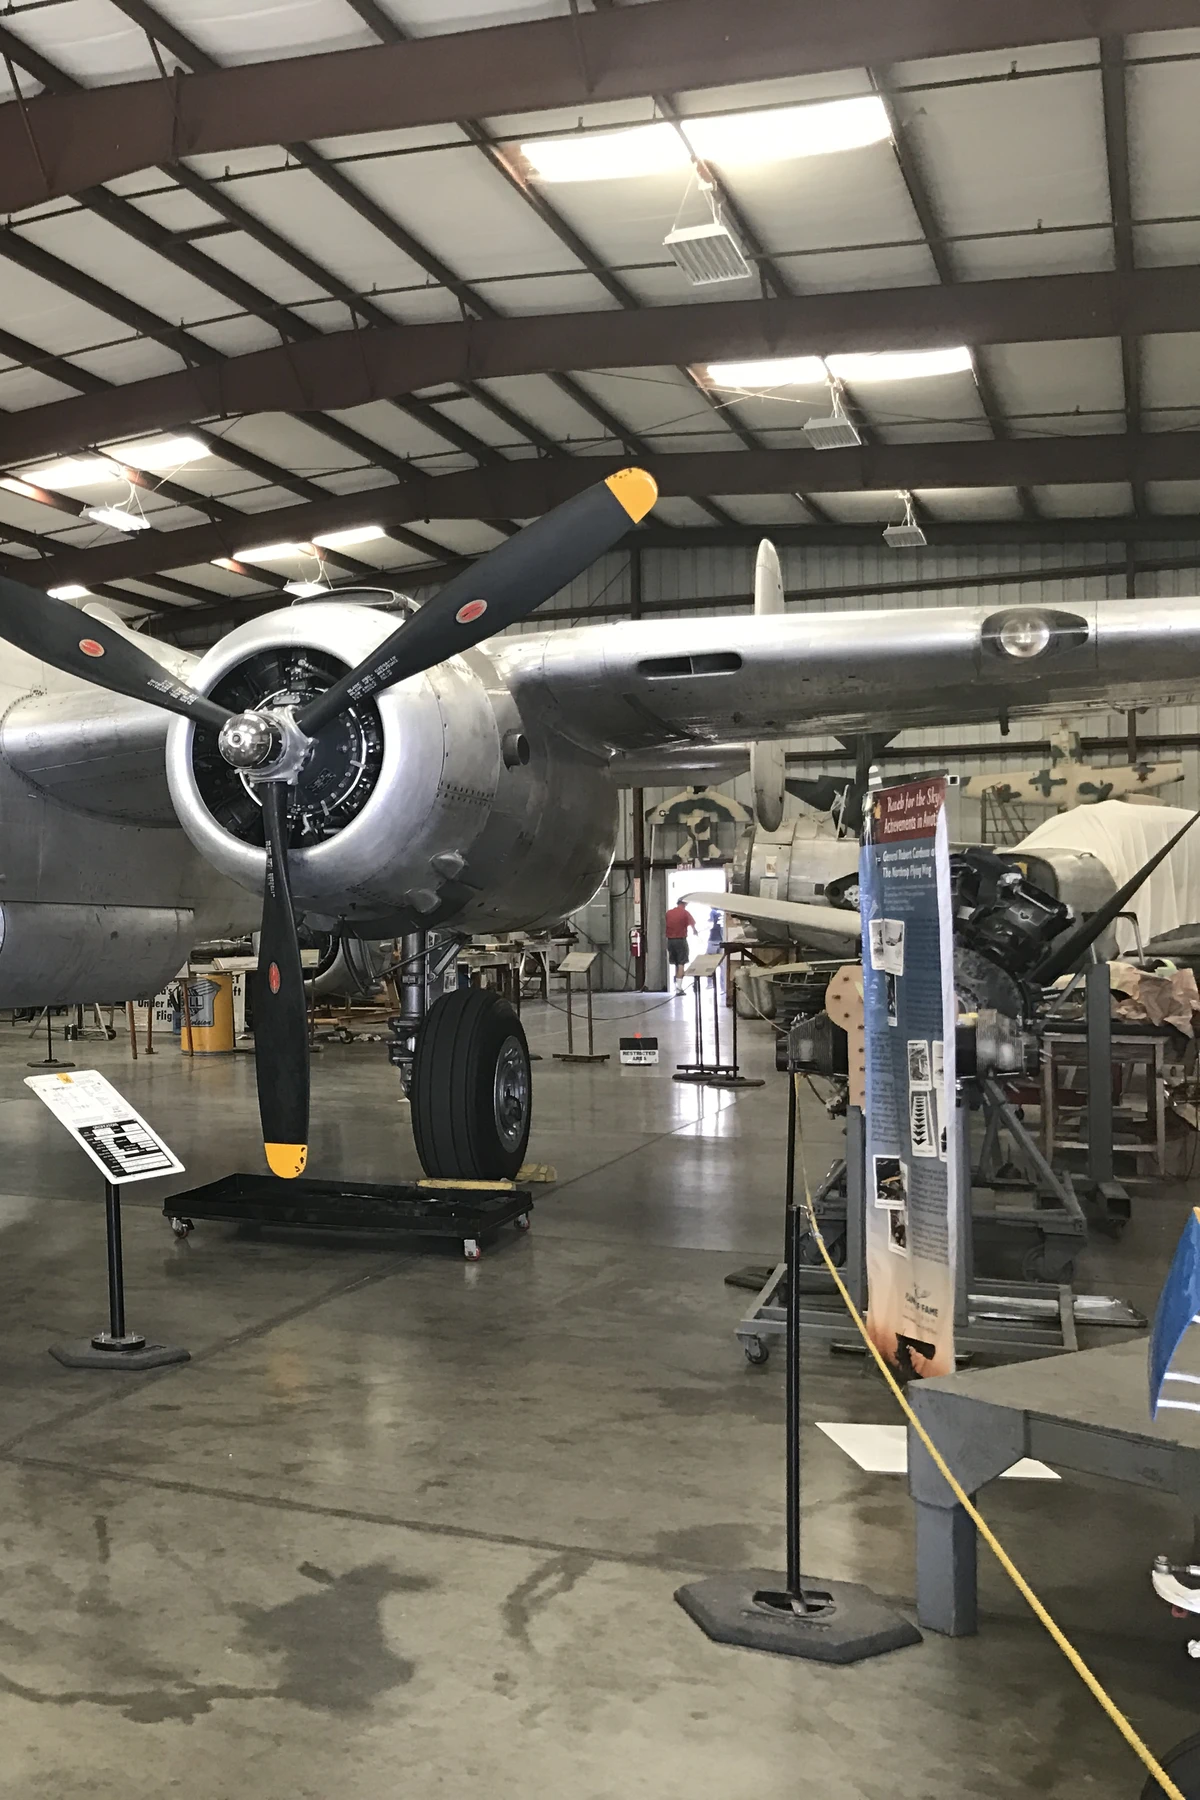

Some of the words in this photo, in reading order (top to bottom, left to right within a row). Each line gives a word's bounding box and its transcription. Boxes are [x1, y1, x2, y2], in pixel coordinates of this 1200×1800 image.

[916, 789, 926, 807] the
[916, 814, 923, 829] in
[156, 1009, 172, 1022] Flig
